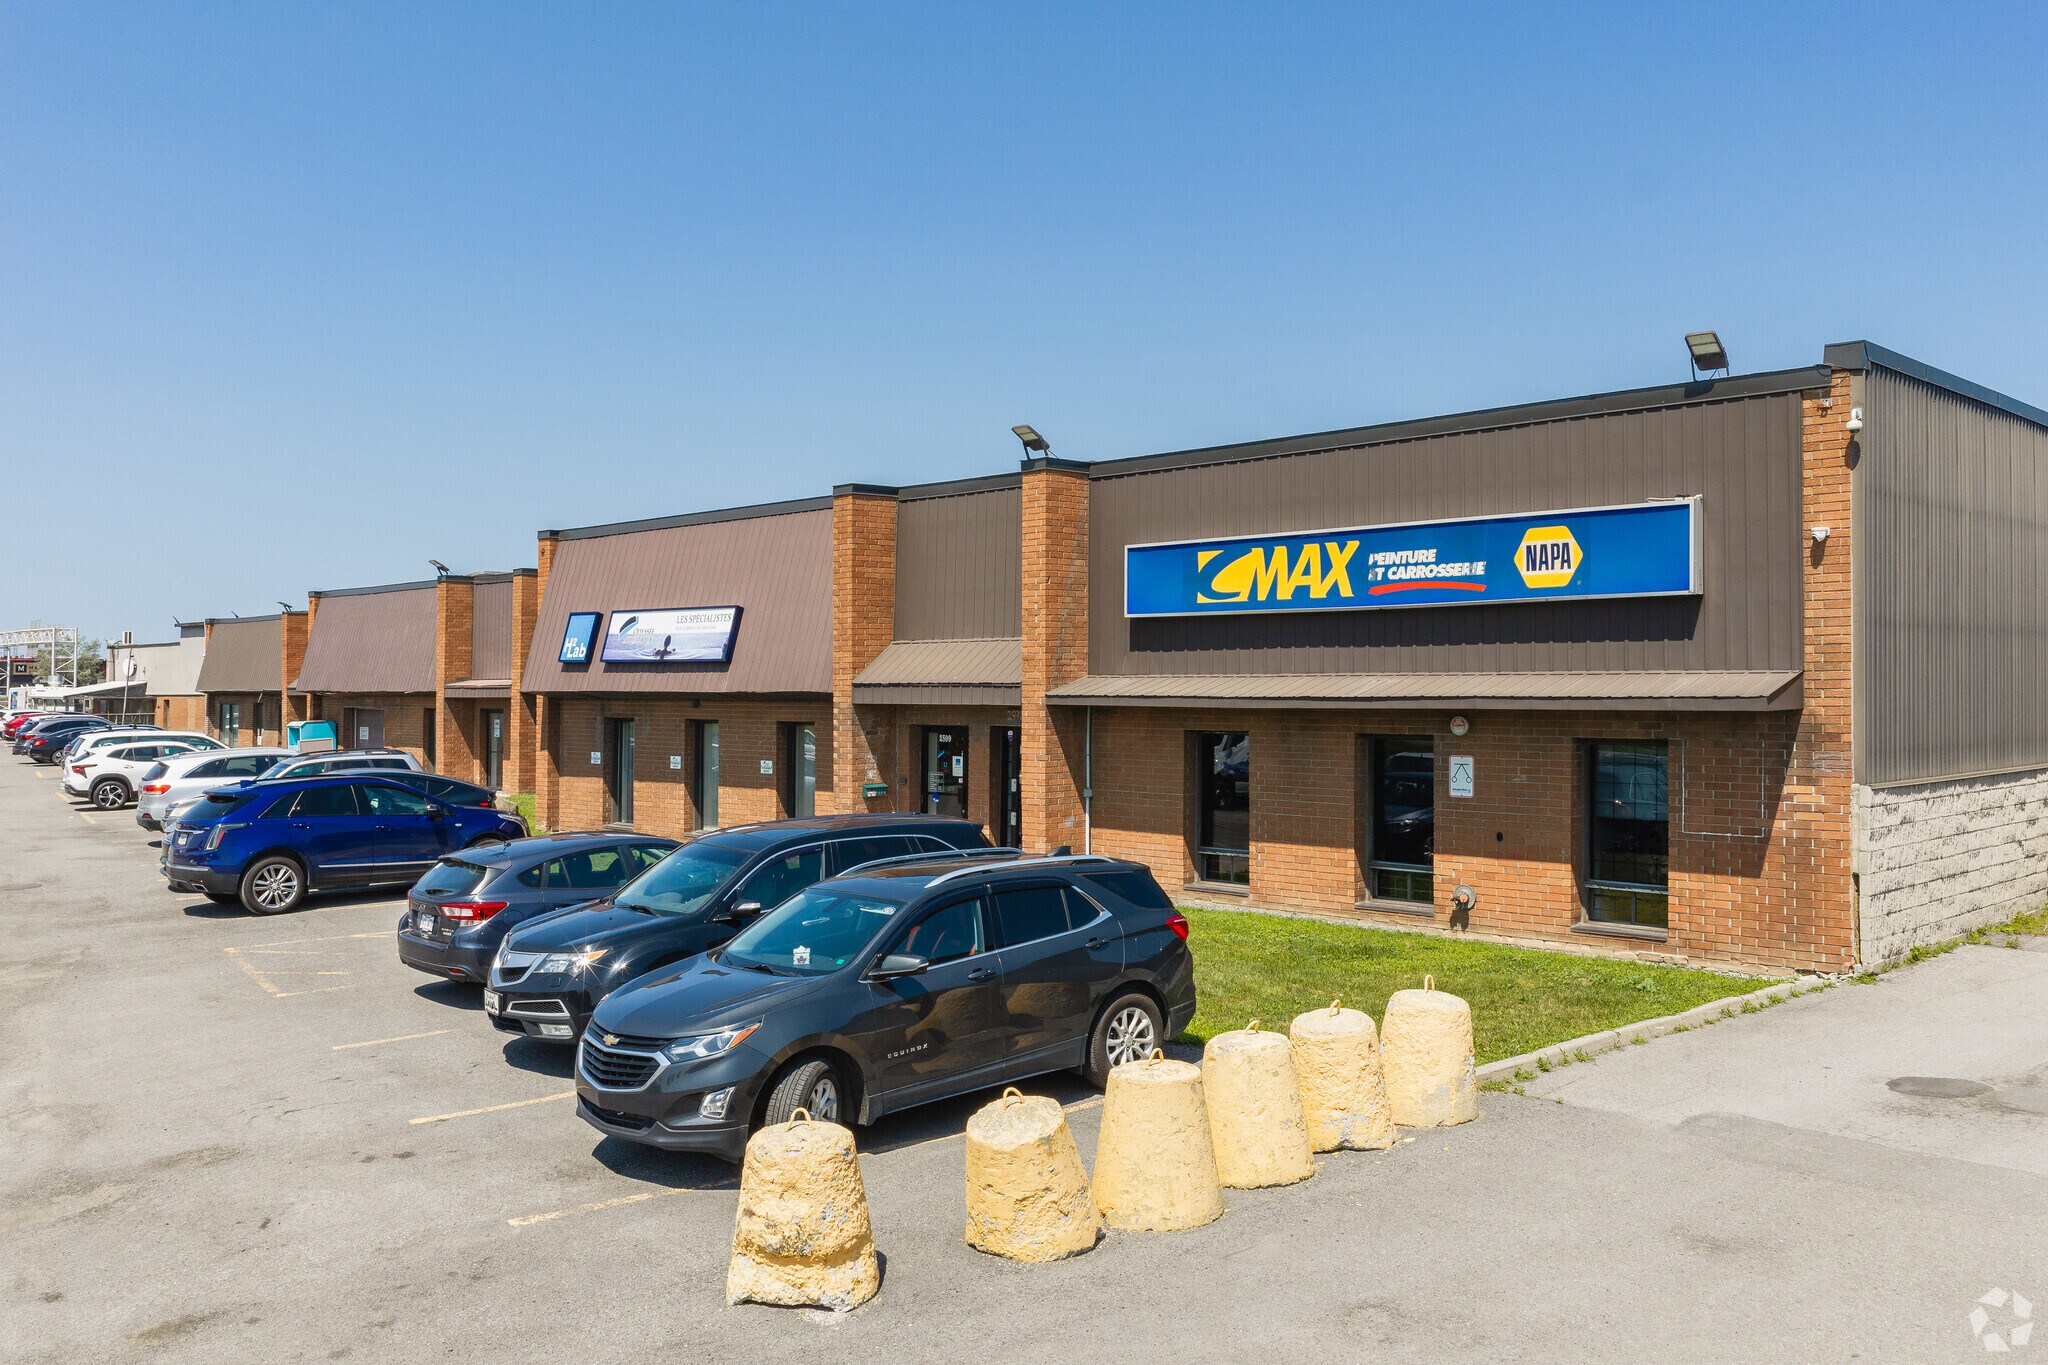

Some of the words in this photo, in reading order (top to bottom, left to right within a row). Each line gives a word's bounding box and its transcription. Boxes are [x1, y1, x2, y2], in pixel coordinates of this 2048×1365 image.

[1368, 549, 1437, 565] PEINTURE
[1525, 542, 1571, 571] NAPA
[1387, 561, 1486, 580] CARROSSERIE
[676, 615, 688, 624] LES
[689, 612, 732, 623] SPÉCIALISTES
[566, 642, 587, 658] Lab
[887, 1043, 928, 1058] EQUINOX
